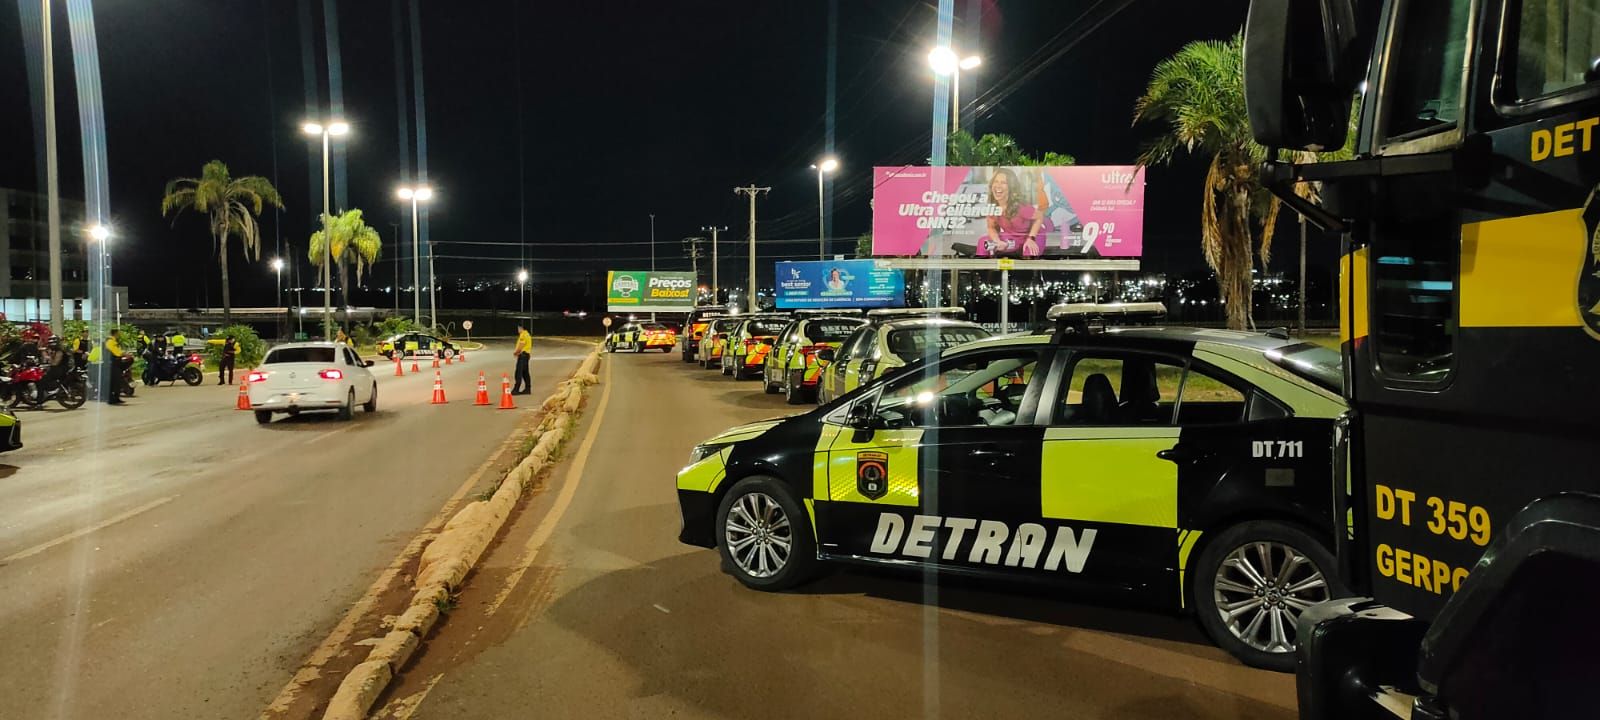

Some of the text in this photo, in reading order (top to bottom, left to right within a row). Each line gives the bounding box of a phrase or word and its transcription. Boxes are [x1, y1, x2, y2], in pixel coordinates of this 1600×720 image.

[1531, 117, 1600, 161] DET
[922, 191, 989, 205] Chegou a
[899, 203, 1003, 216] Ultra Ceilândia
[916, 217, 967, 229] QNN32
[649, 277, 692, 290] Preços
[651, 288, 690, 297] Baixos!
[1252, 441, 1303, 457] DT 711
[1376, 485, 1491, 546] DT 359
[870, 512, 1098, 573] DETRAN
